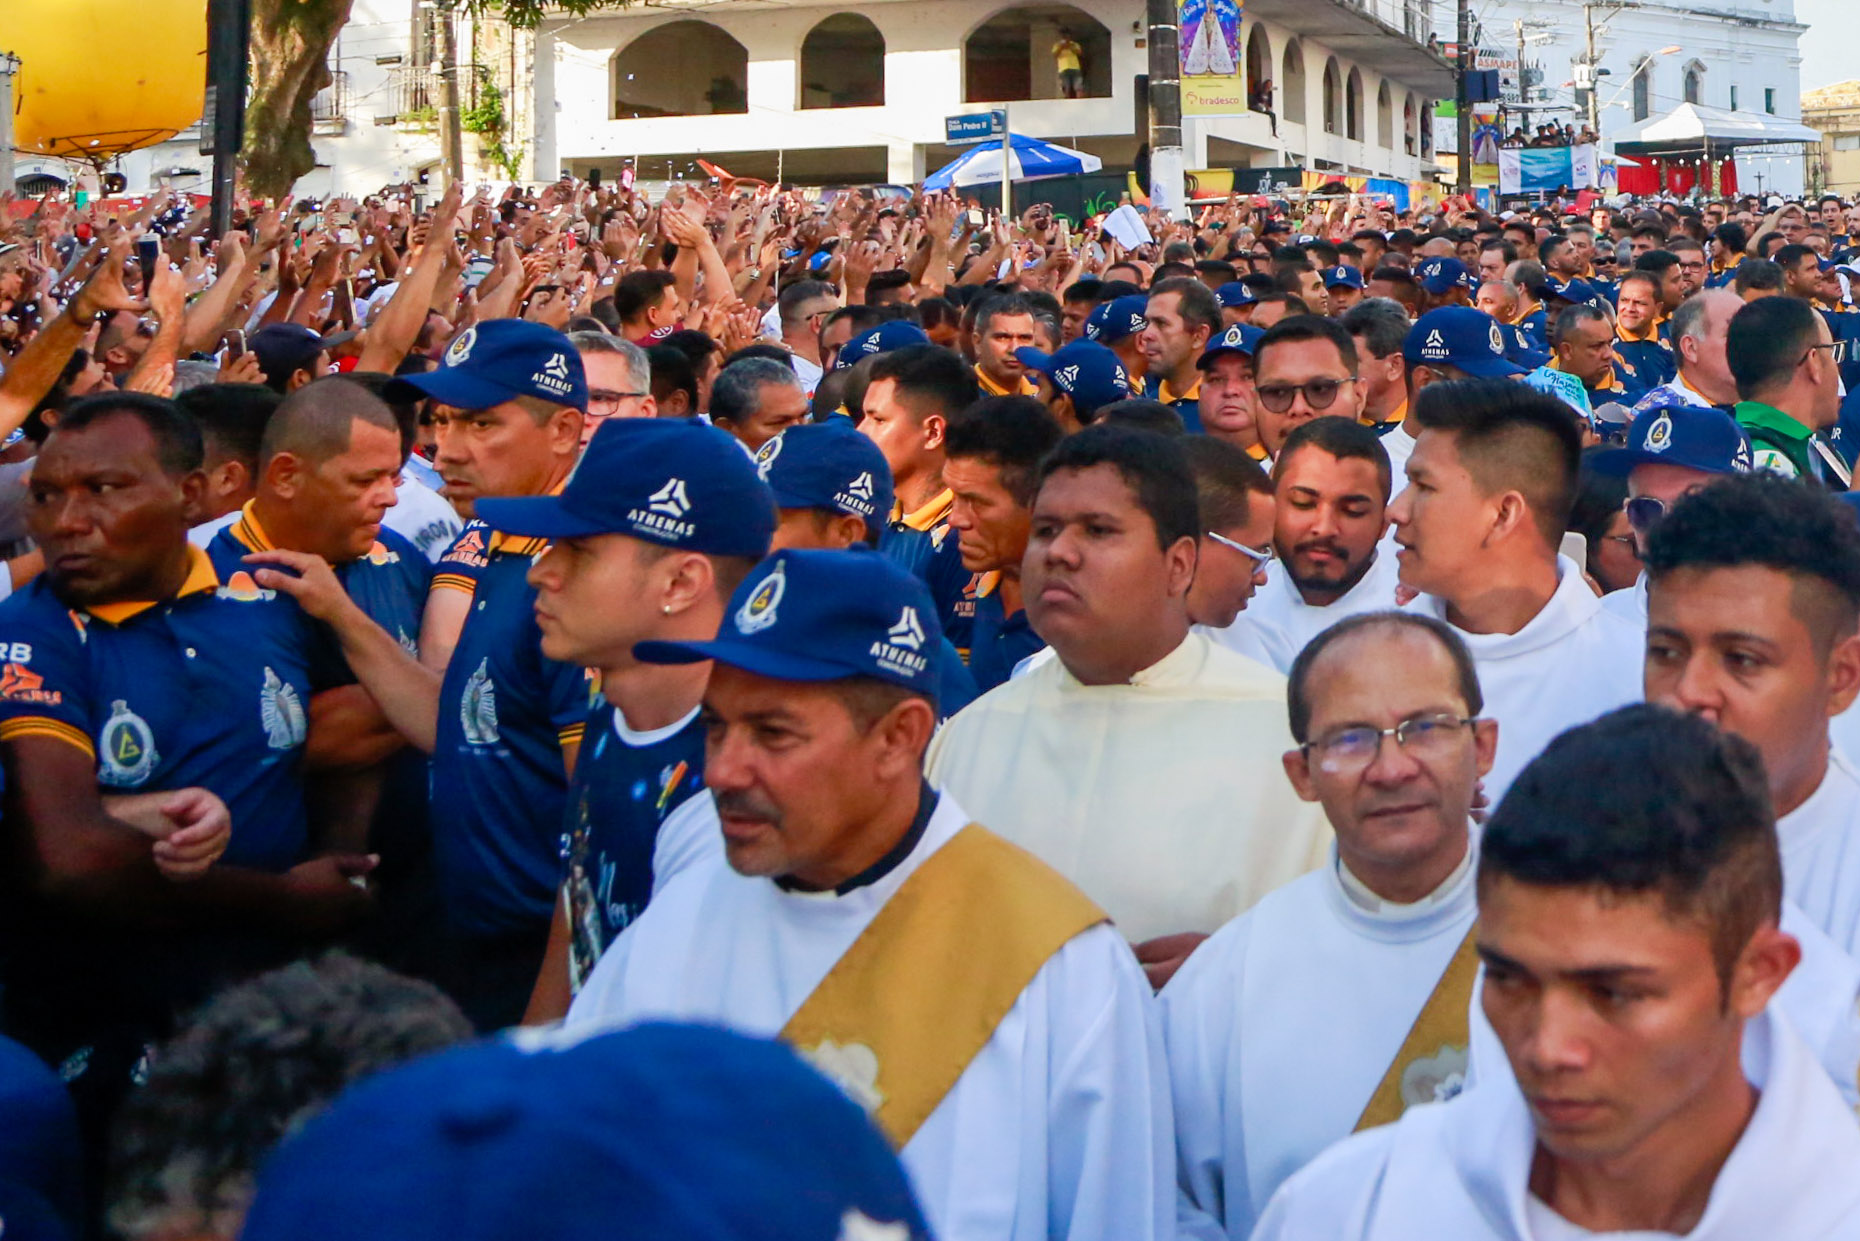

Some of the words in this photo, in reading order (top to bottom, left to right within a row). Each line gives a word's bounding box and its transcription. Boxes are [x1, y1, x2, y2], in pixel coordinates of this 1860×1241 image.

[1199, 95, 1240, 105] bradesco
[531, 372, 573, 393] ATHENAS
[833, 492, 875, 515] ATHENAS
[627, 509, 696, 537] ATHENAS
[870, 641, 929, 672] ATHENAS
